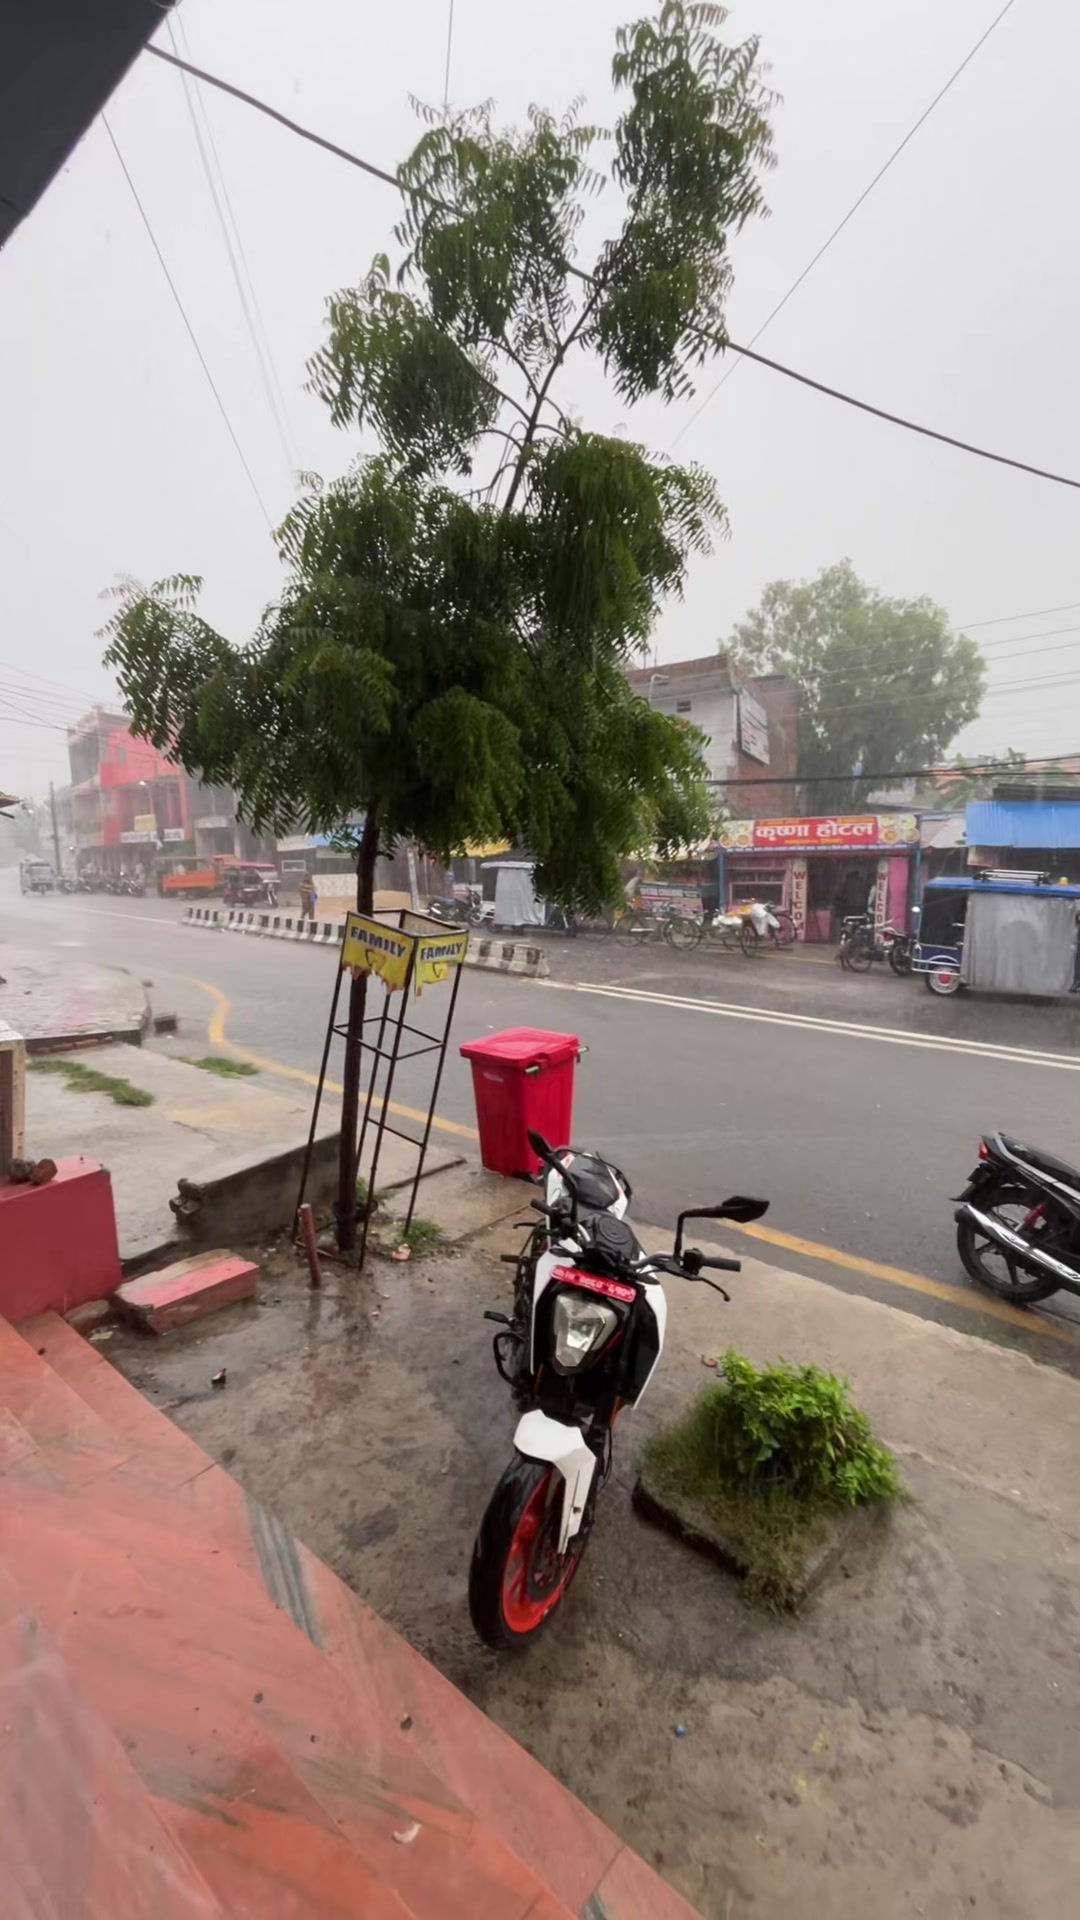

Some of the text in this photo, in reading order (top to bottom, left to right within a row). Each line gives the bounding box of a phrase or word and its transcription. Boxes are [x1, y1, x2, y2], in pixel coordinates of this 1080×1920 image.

[817, 820, 875, 837] होटल
[351, 926, 406, 957] FAMILY
[420, 942, 463, 960] FAMILY
